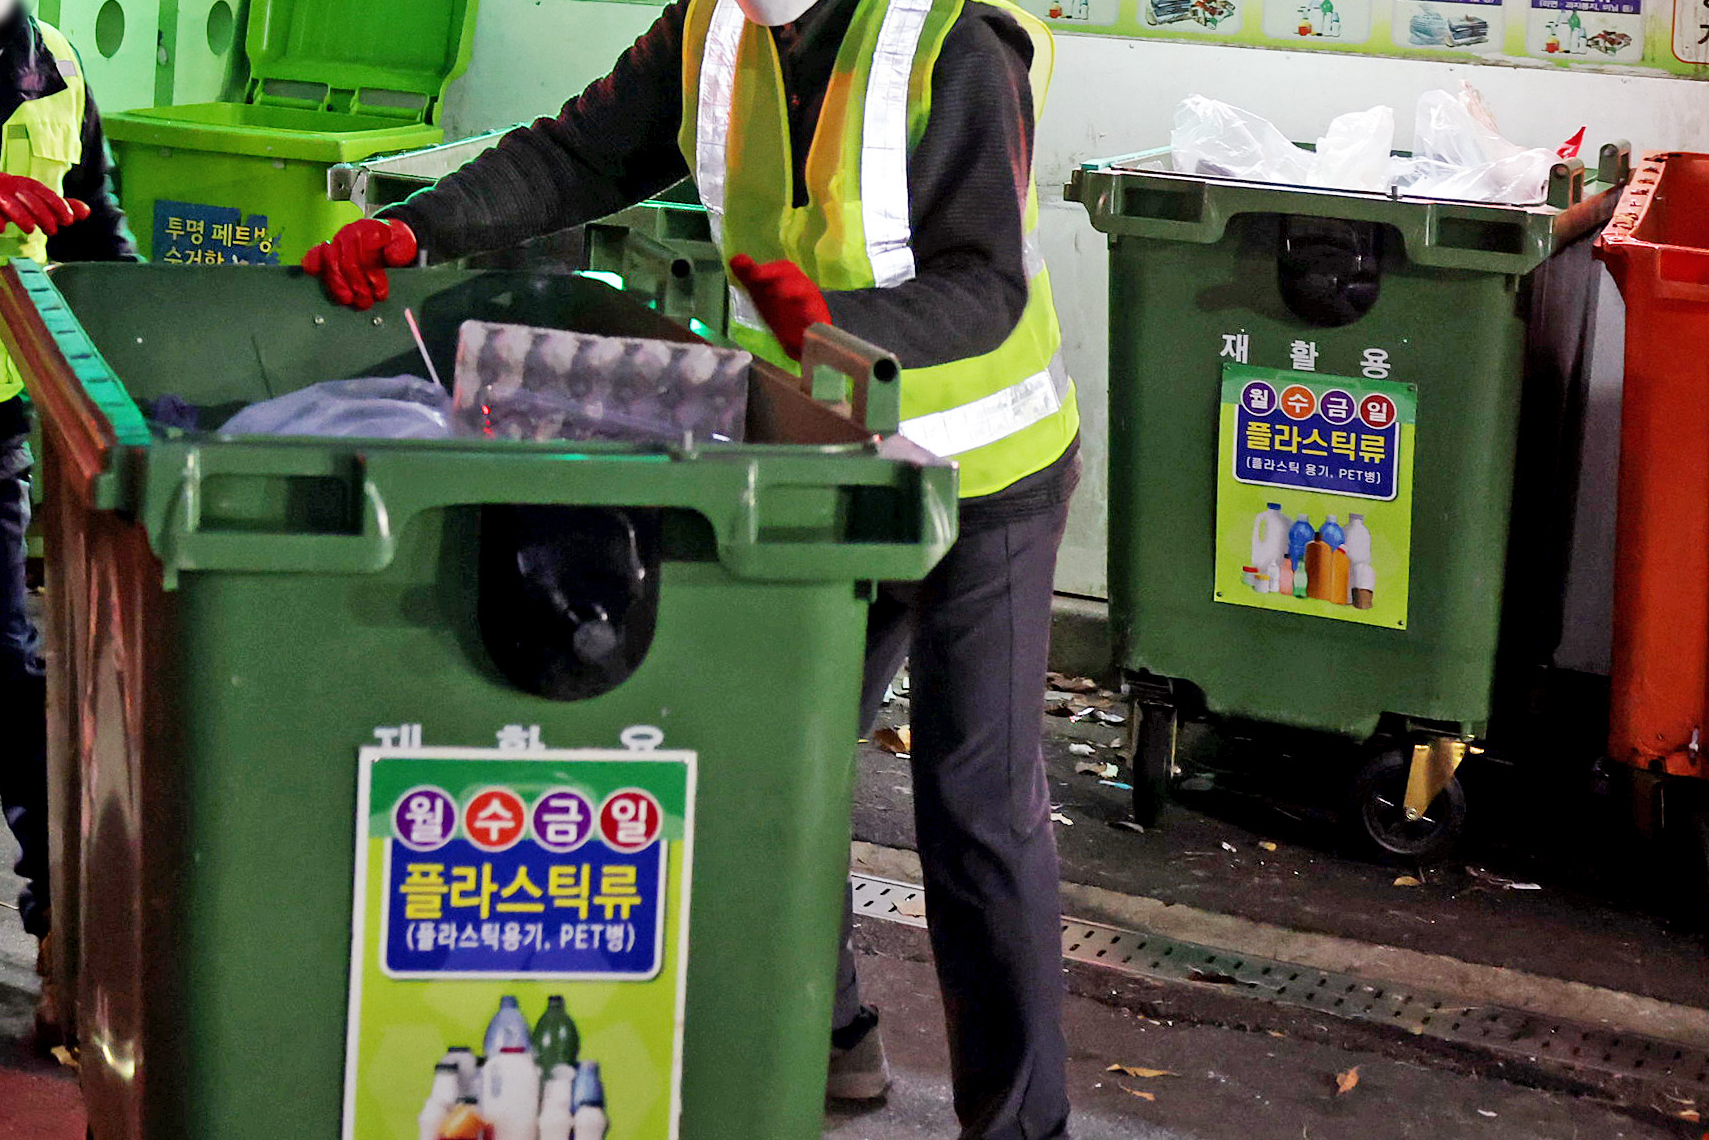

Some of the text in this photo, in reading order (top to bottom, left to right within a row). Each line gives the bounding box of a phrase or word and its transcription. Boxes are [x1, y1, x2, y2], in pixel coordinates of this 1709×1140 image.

[164, 216, 205, 245] 투명
[1248, 388, 1387, 423] 월 수 금 일
[1245, 421, 1386, 464] 플라스틱류
[1246, 456, 1300, 474] (플라스틱
[1339, 469, 1381, 485] PET병)
[405, 794, 648, 844] 월 수 금 일
[399, 862, 642, 921] 플라스틱류
[560, 923, 636, 953] PET병)
